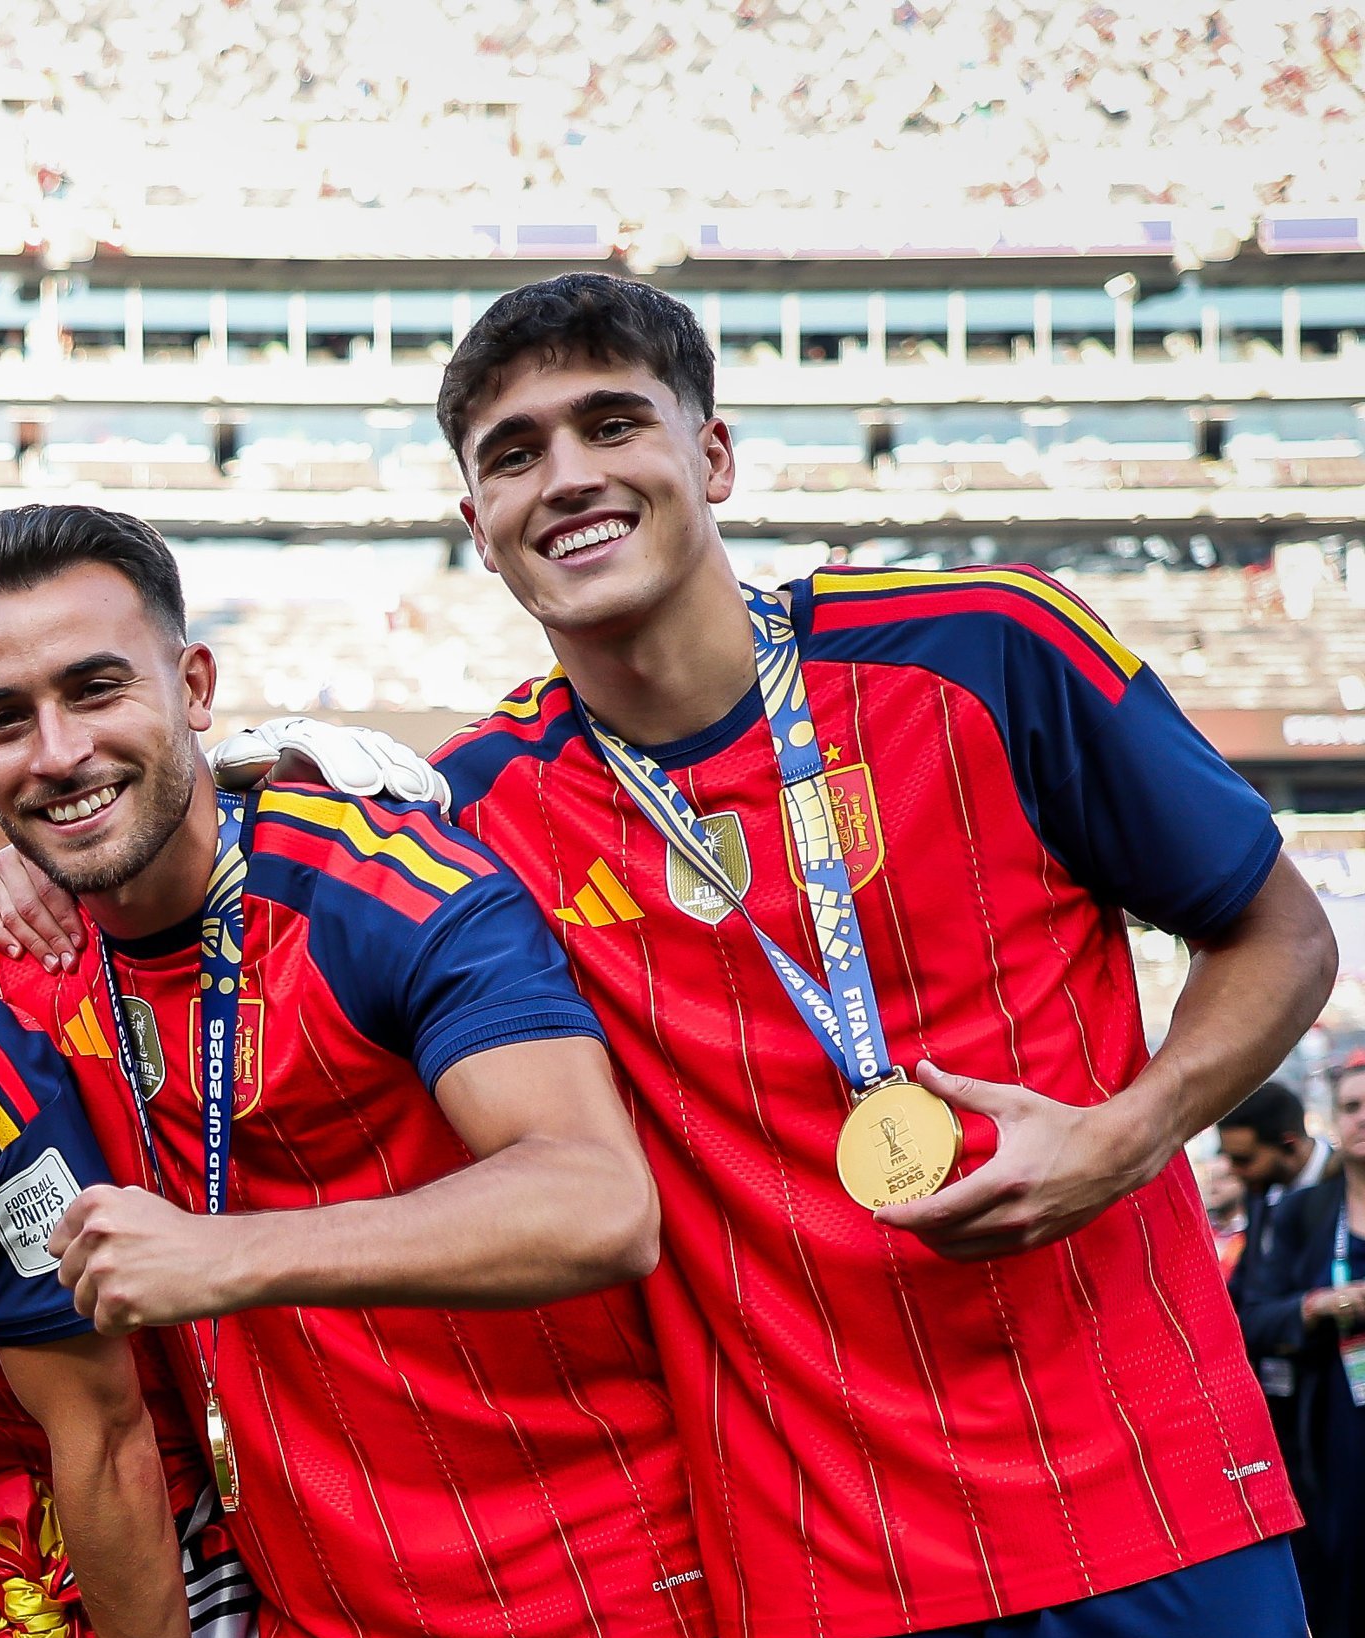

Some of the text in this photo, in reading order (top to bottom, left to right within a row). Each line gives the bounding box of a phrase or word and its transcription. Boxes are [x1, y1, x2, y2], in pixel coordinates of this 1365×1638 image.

[770, 949, 806, 991] FIFA
[842, 986, 870, 1041] FIFA
[208, 1017, 225, 1214] ORLD CUP 2026
[4, 1172, 55, 1213] FOOTBALL
[888, 1173, 926, 1196] 2026
[8, 1186, 65, 1230] UNITES
[19, 1232, 42, 1249] the
